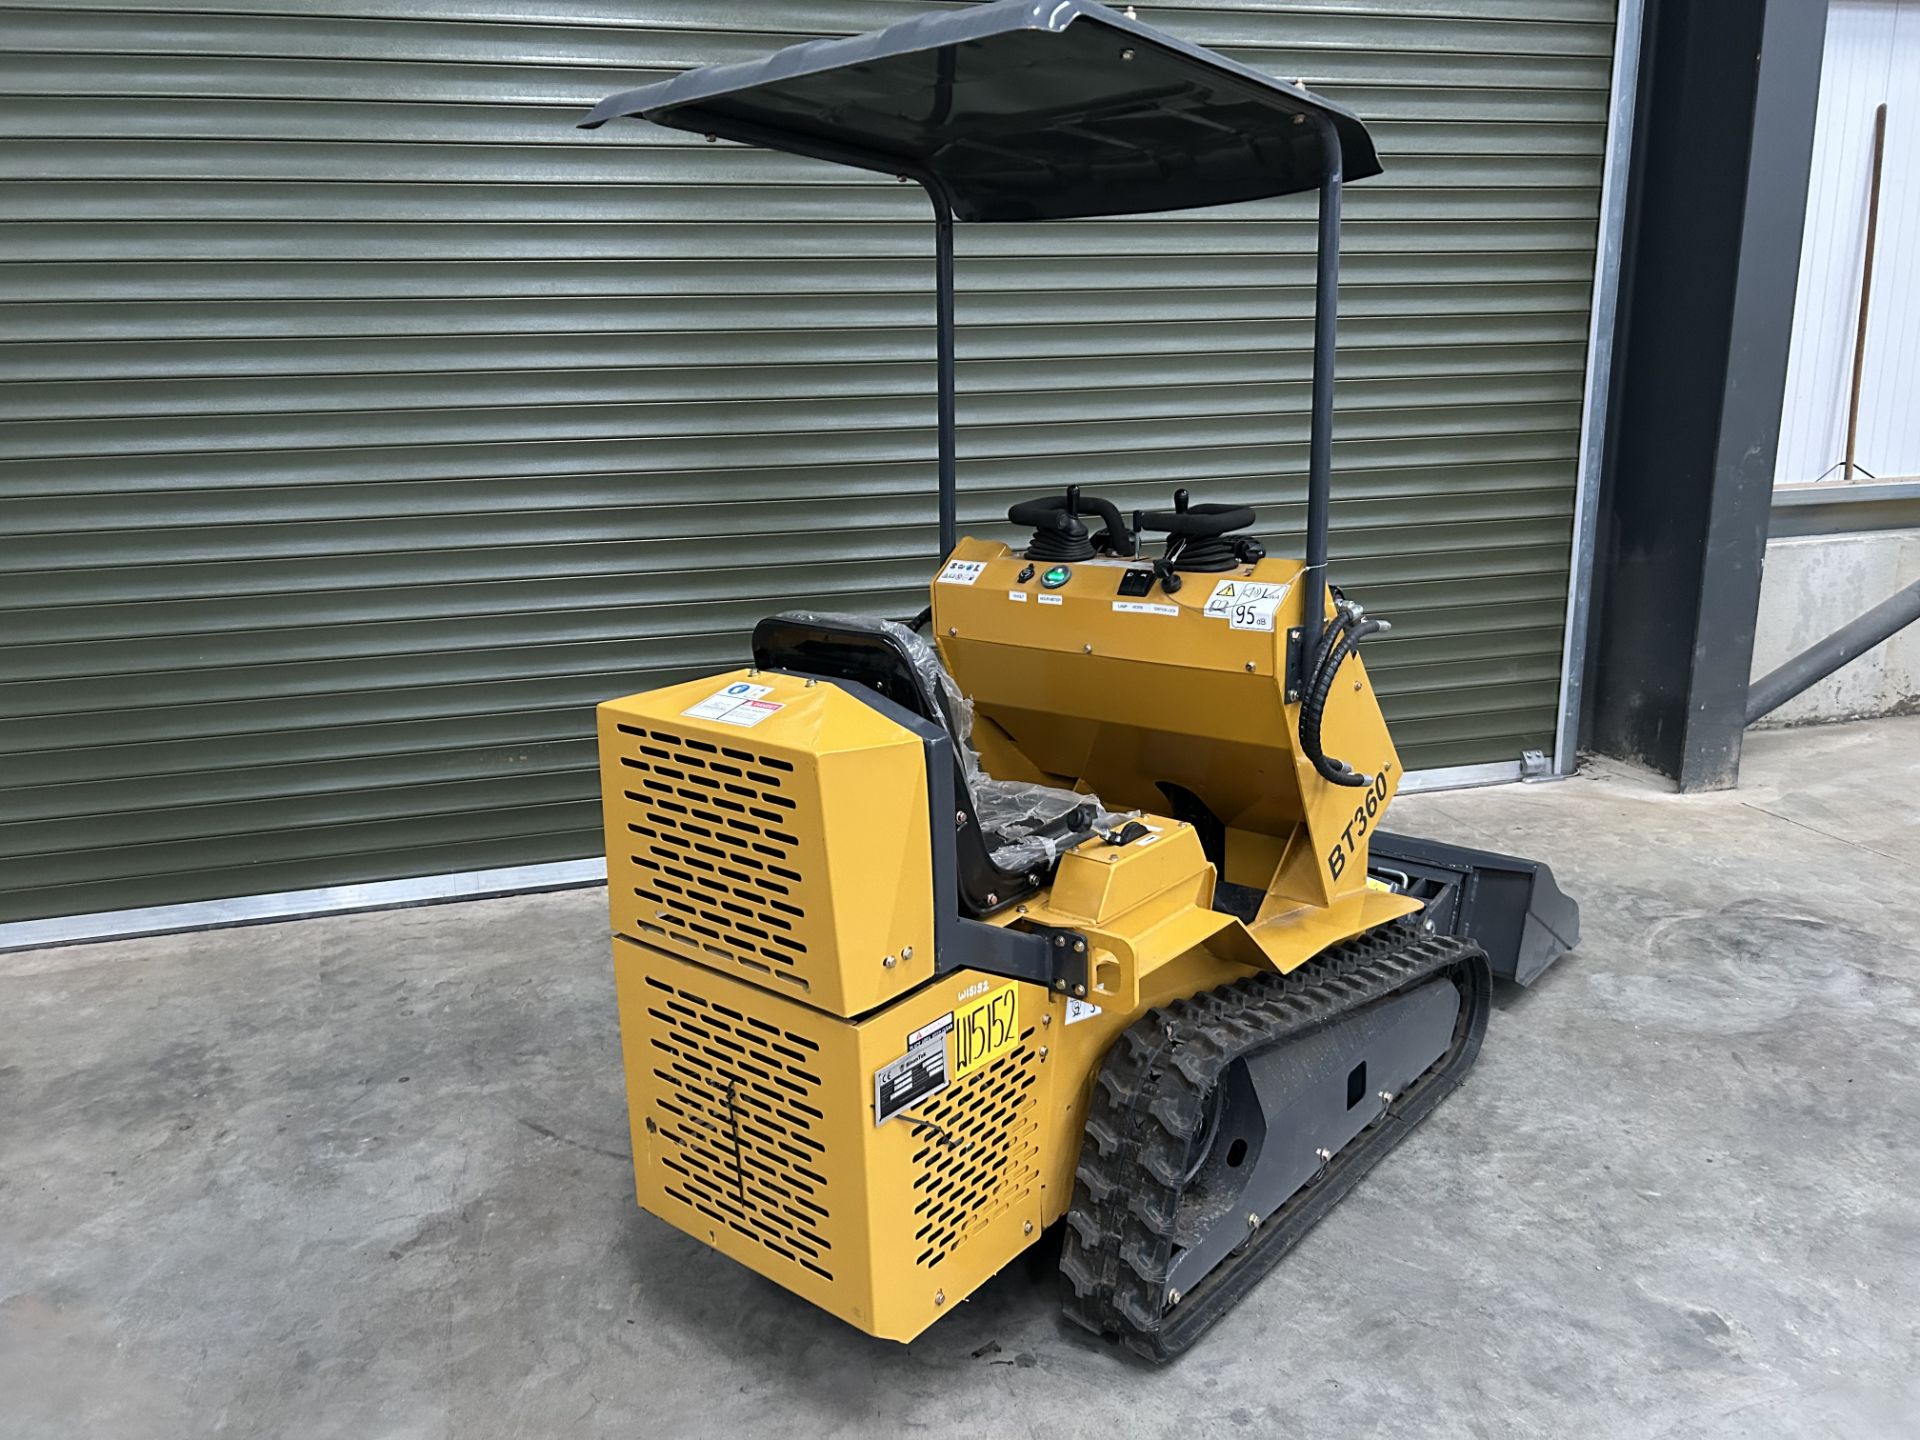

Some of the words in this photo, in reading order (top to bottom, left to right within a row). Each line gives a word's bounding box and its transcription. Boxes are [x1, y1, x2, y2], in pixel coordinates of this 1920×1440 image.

[1235, 605, 1257, 625] 95
[1327, 771, 1387, 882] BT360
[956, 989, 1015, 1072] W15152
[882, 1070, 892, 1083] CE
